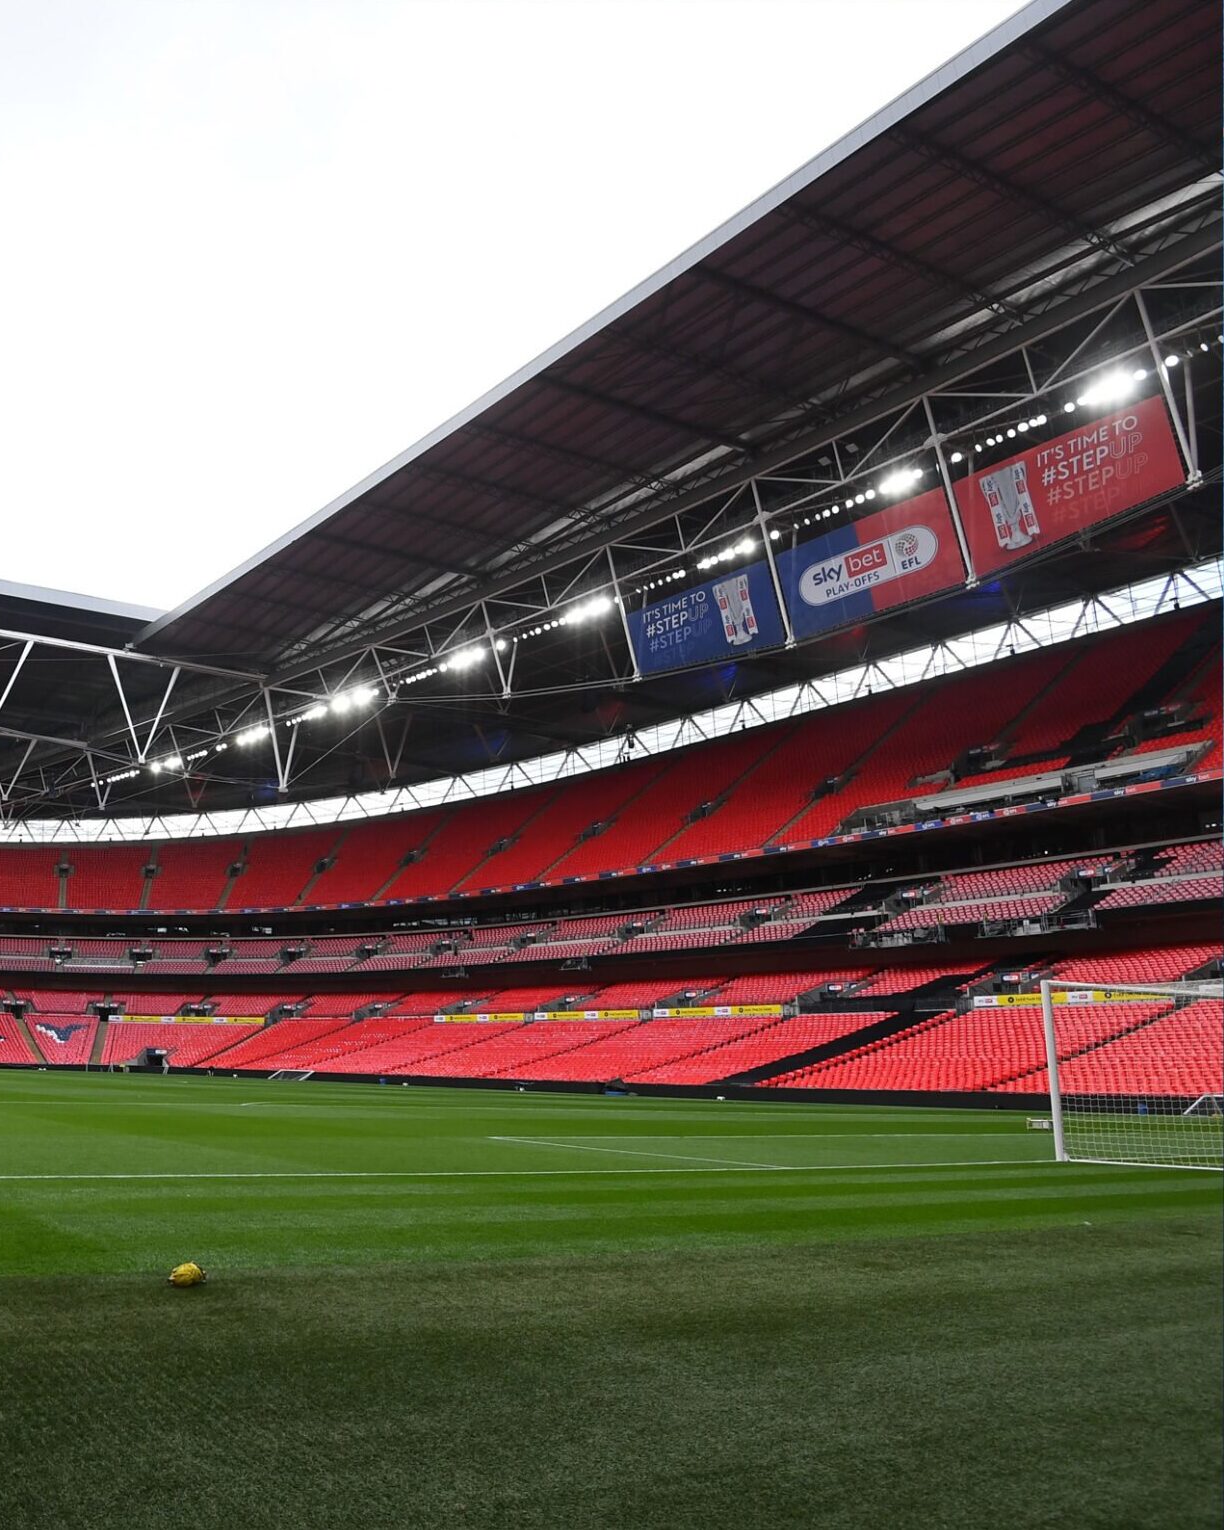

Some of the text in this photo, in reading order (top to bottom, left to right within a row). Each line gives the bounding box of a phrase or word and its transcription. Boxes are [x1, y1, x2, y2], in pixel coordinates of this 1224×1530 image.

[1036, 415, 1138, 467] IT'S TIME TO
[1041, 431, 1143, 487] #STEPUP
[812, 548, 883, 586] sky bet
[901, 556, 921, 570] EFL
[825, 571, 880, 598] PLAY-OFFS
[643, 590, 706, 624] IT'S TIME TO
[646, 602, 709, 638] #STEPUP
